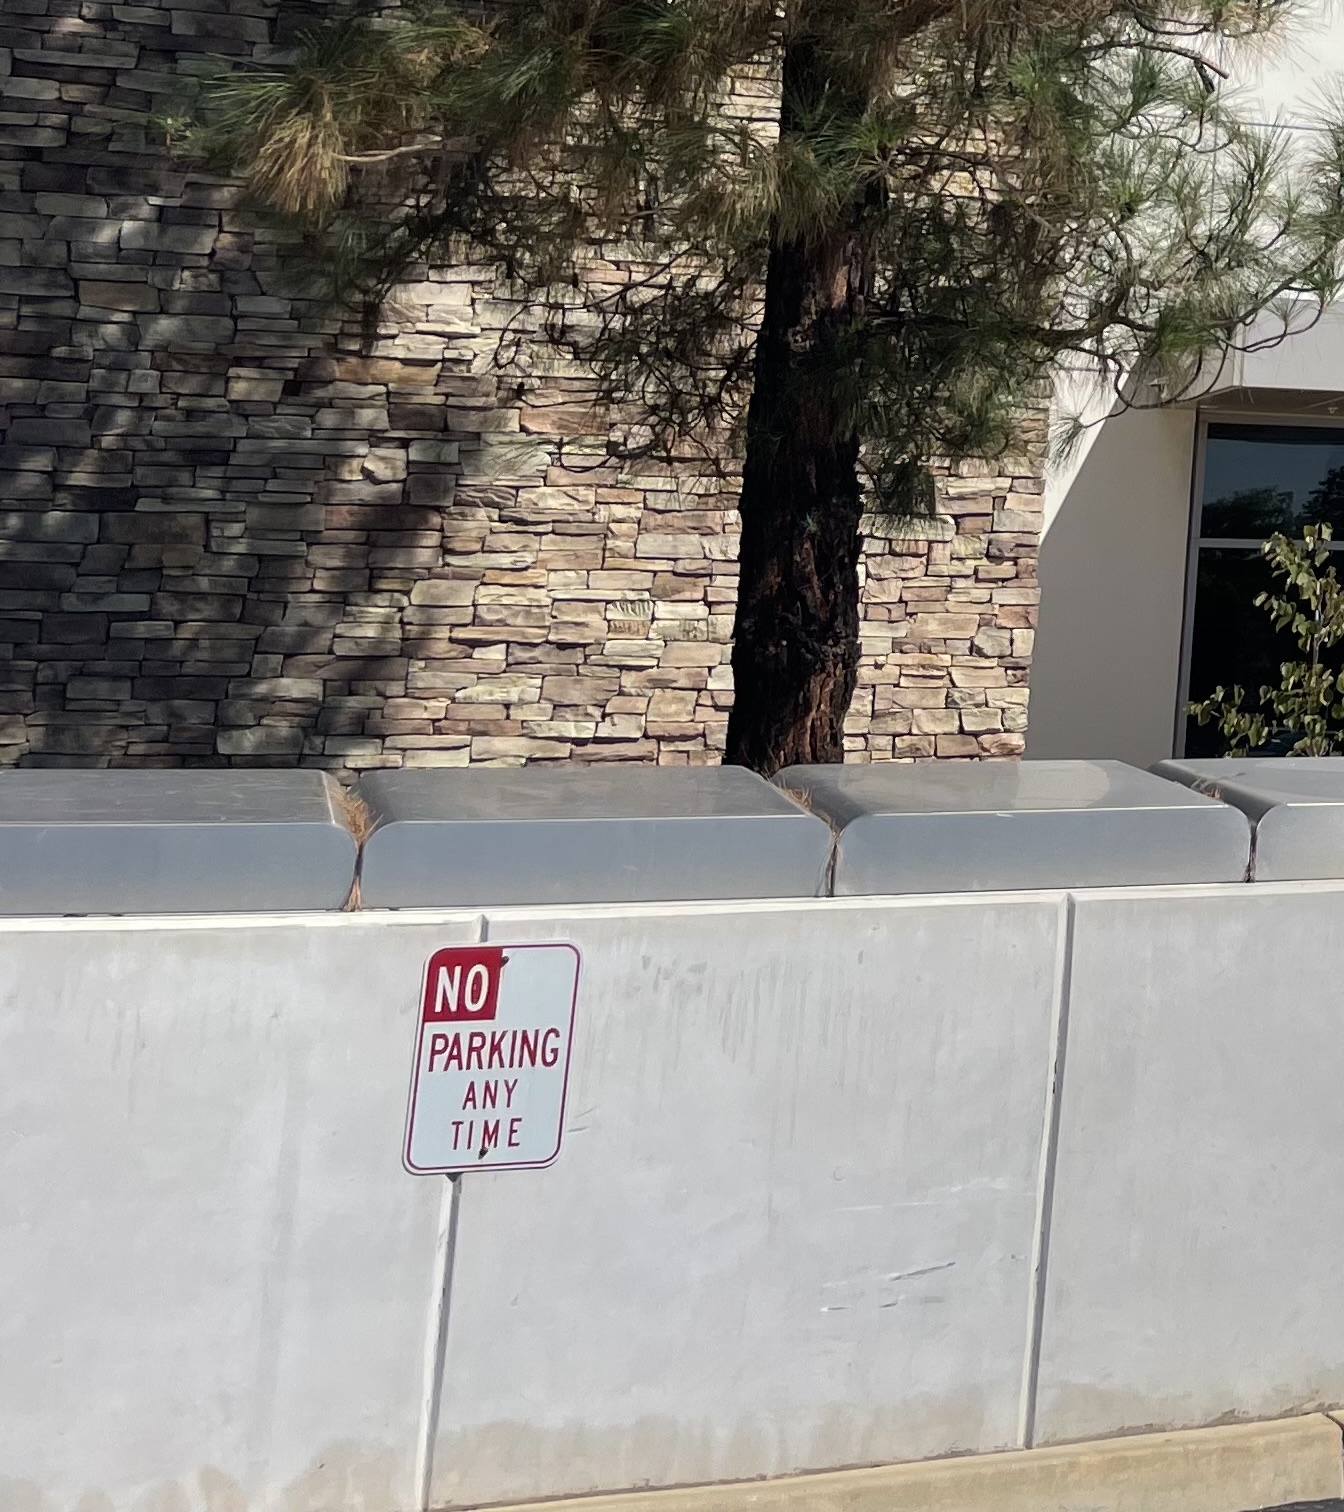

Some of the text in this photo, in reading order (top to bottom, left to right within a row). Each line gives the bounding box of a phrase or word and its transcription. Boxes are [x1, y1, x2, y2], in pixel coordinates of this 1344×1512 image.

[434, 964, 489, 1013] NO
[428, 1027, 560, 1072] PARKING
[462, 1078, 518, 1110] ANY
[451, 1117, 522, 1151] TIME
